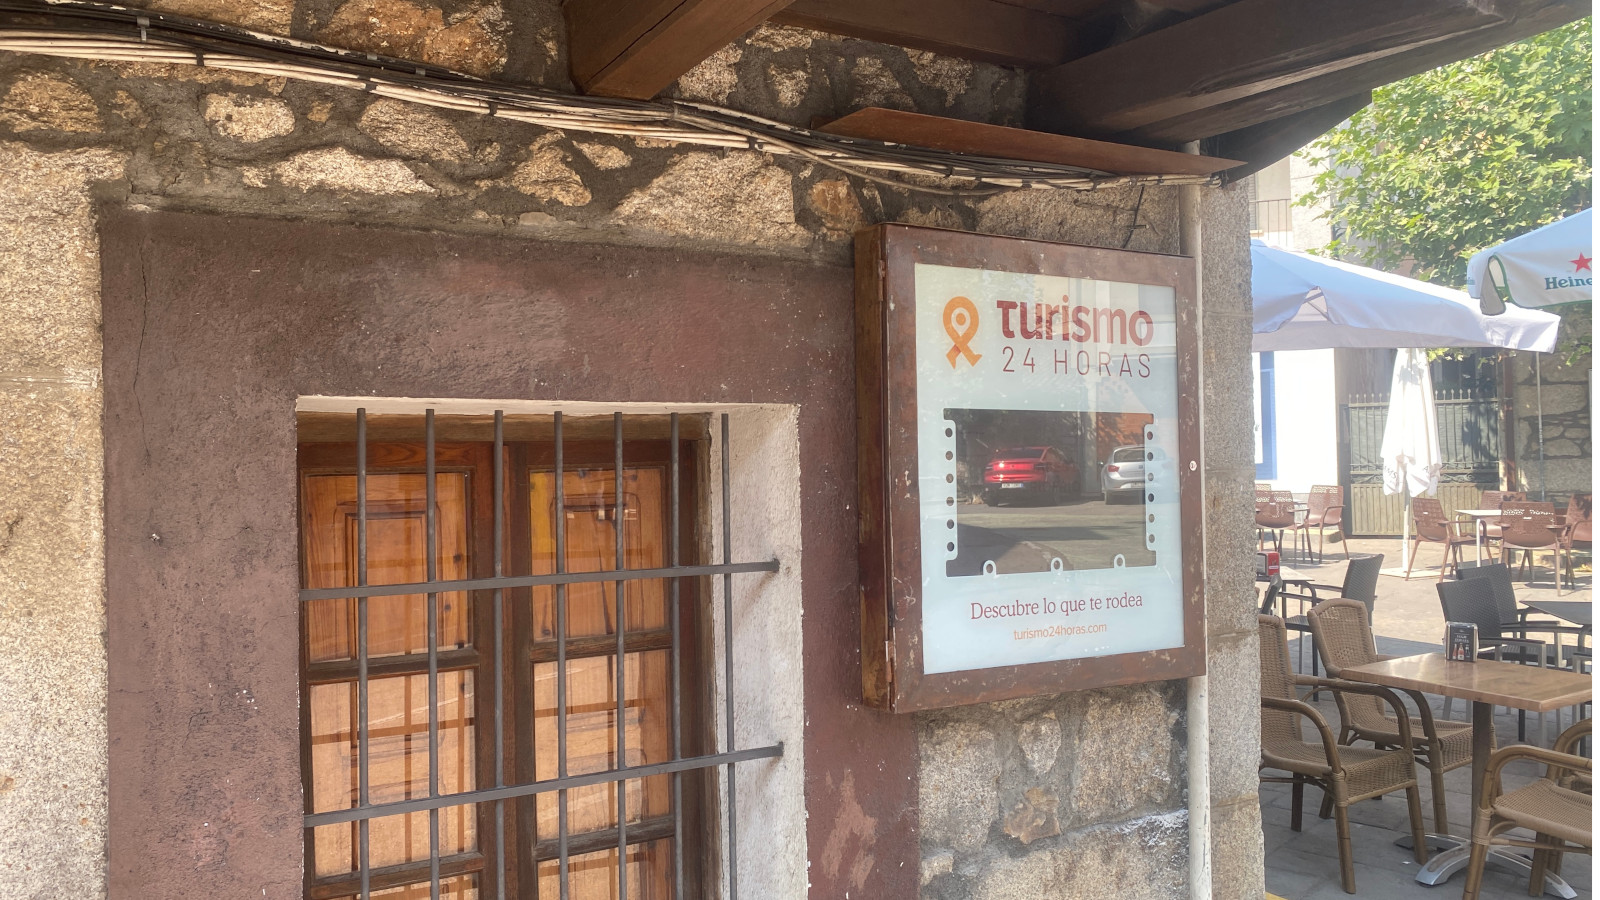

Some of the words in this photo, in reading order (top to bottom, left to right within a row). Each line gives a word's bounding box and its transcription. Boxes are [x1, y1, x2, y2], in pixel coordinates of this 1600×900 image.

[1002, 346, 1036, 374] 24
[1054, 349, 1151, 378] HORAS
[970, 600, 1039, 620] Descubre
[1043, 597, 1056, 614] lo
[1060, 599, 1086, 617] que
[1089, 596, 1102, 611] te
[1106, 592, 1143, 609] rodea
[1013, 623, 1107, 641] turismo24horas.com
